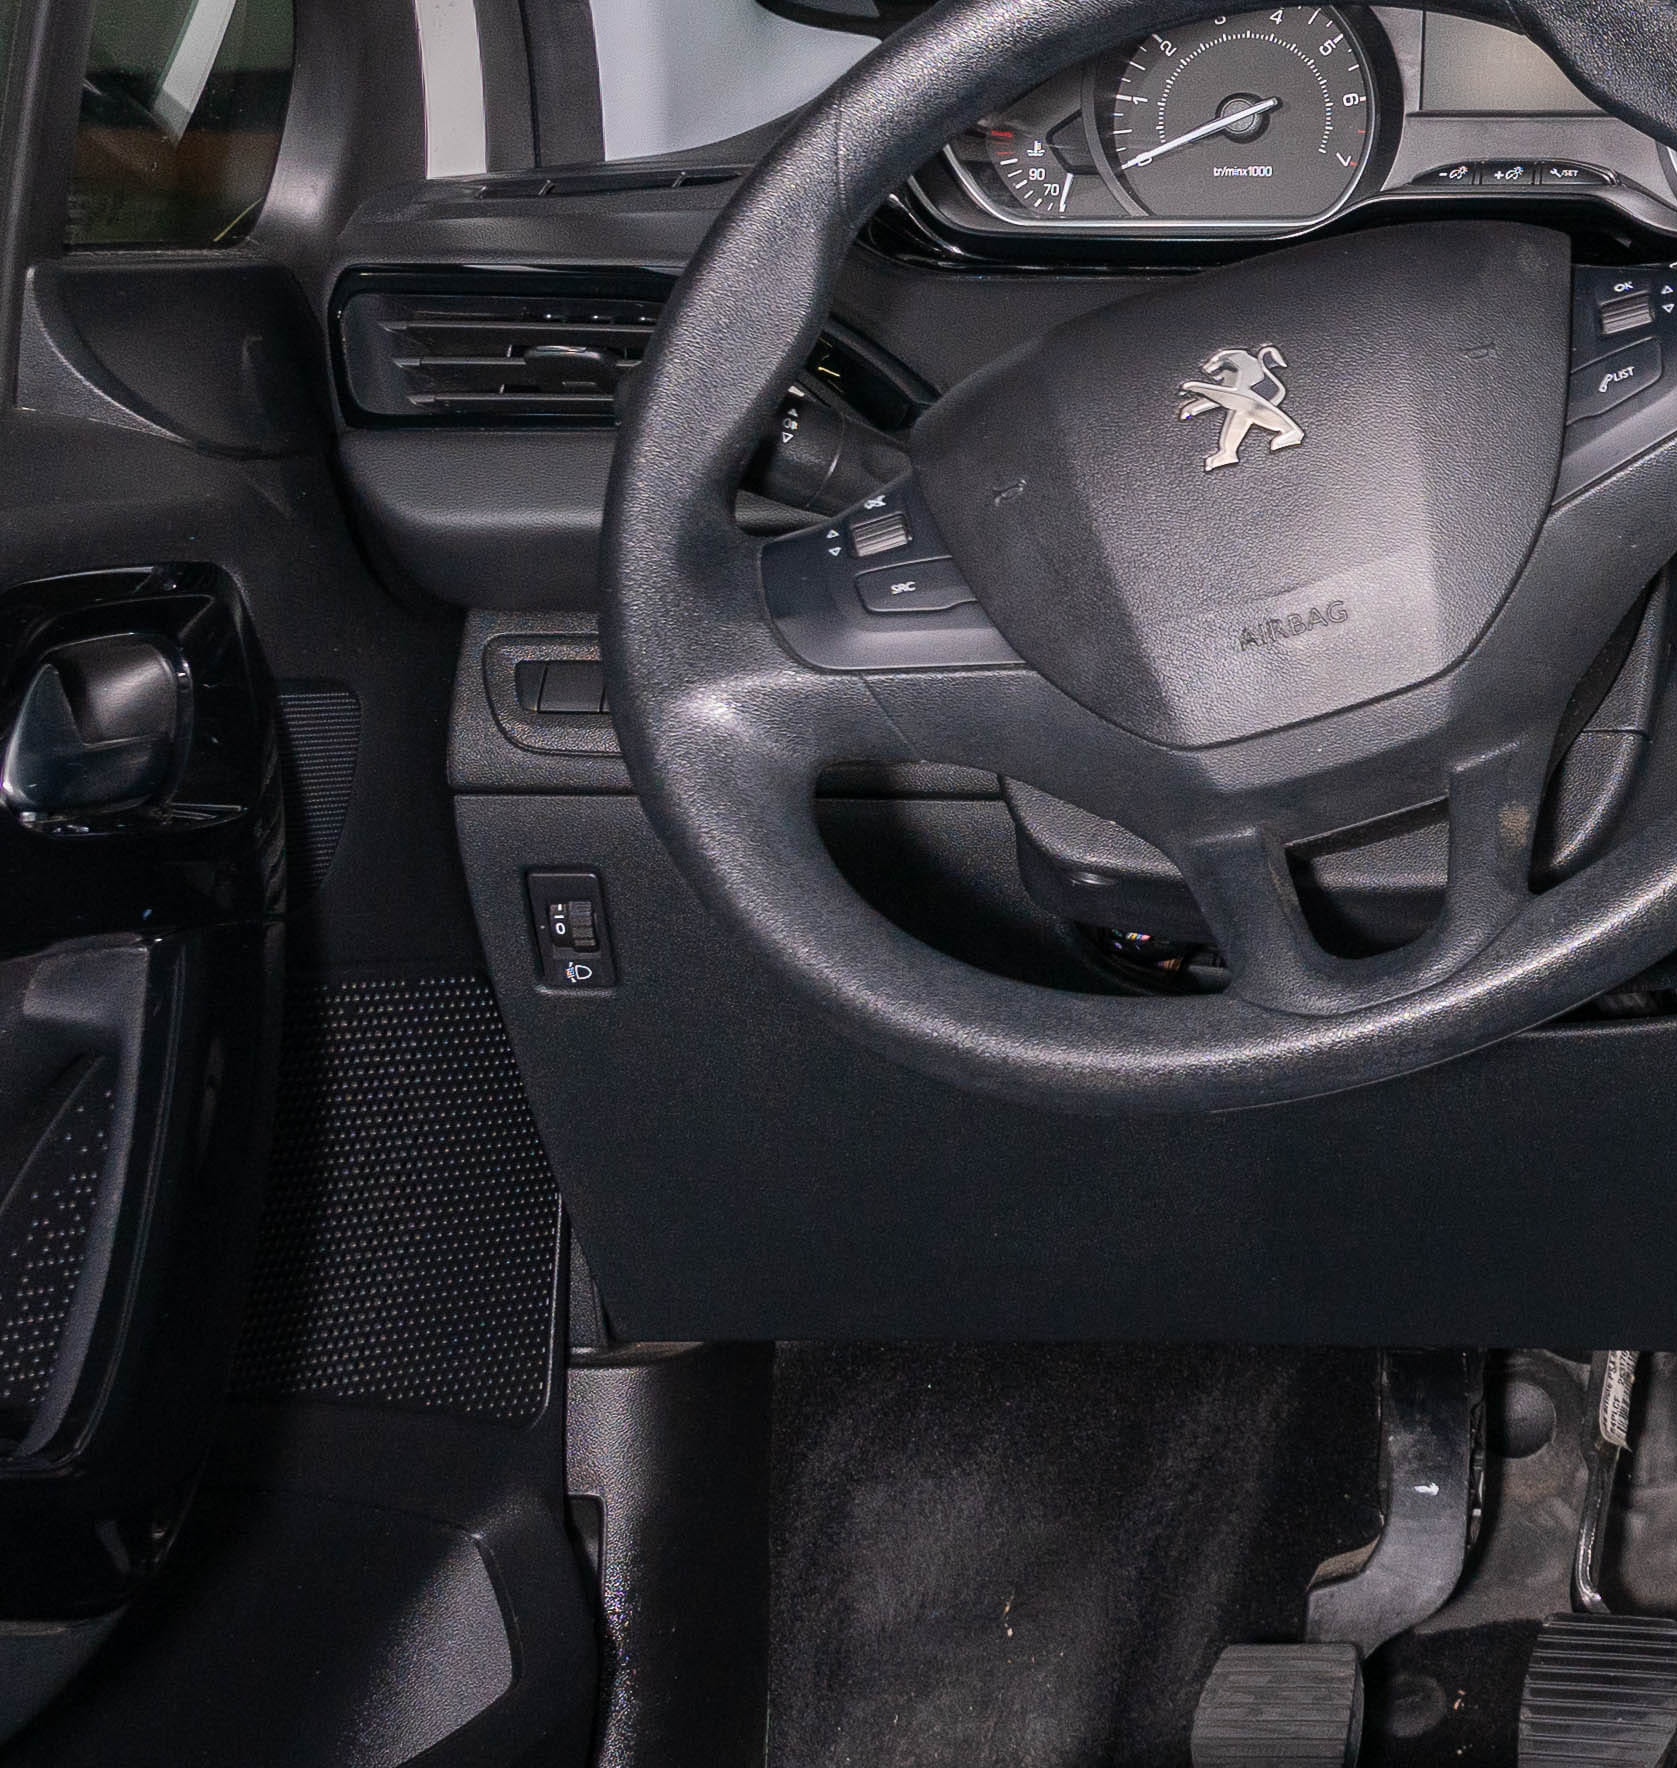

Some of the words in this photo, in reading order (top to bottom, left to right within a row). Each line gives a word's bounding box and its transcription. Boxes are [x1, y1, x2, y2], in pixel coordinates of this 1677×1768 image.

[1269, 9, 1284, 25] 4
[1160, 40, 1178, 57] 2
[1319, 39, 1336, 56] 5
[1132, 95, 1149, 105] 1
[1342, 93, 1358, 107] 6
[1336, 152, 1351, 166] 7
[1028, 168, 1046, 181] 90
[1042, 183, 1060, 196] 70
[1613, 281, 1634, 293] OK
[1613, 366, 1635, 383] LIST
[890, 580, 917, 595] SRC
[1239, 599, 1349, 652] AIRBAG
